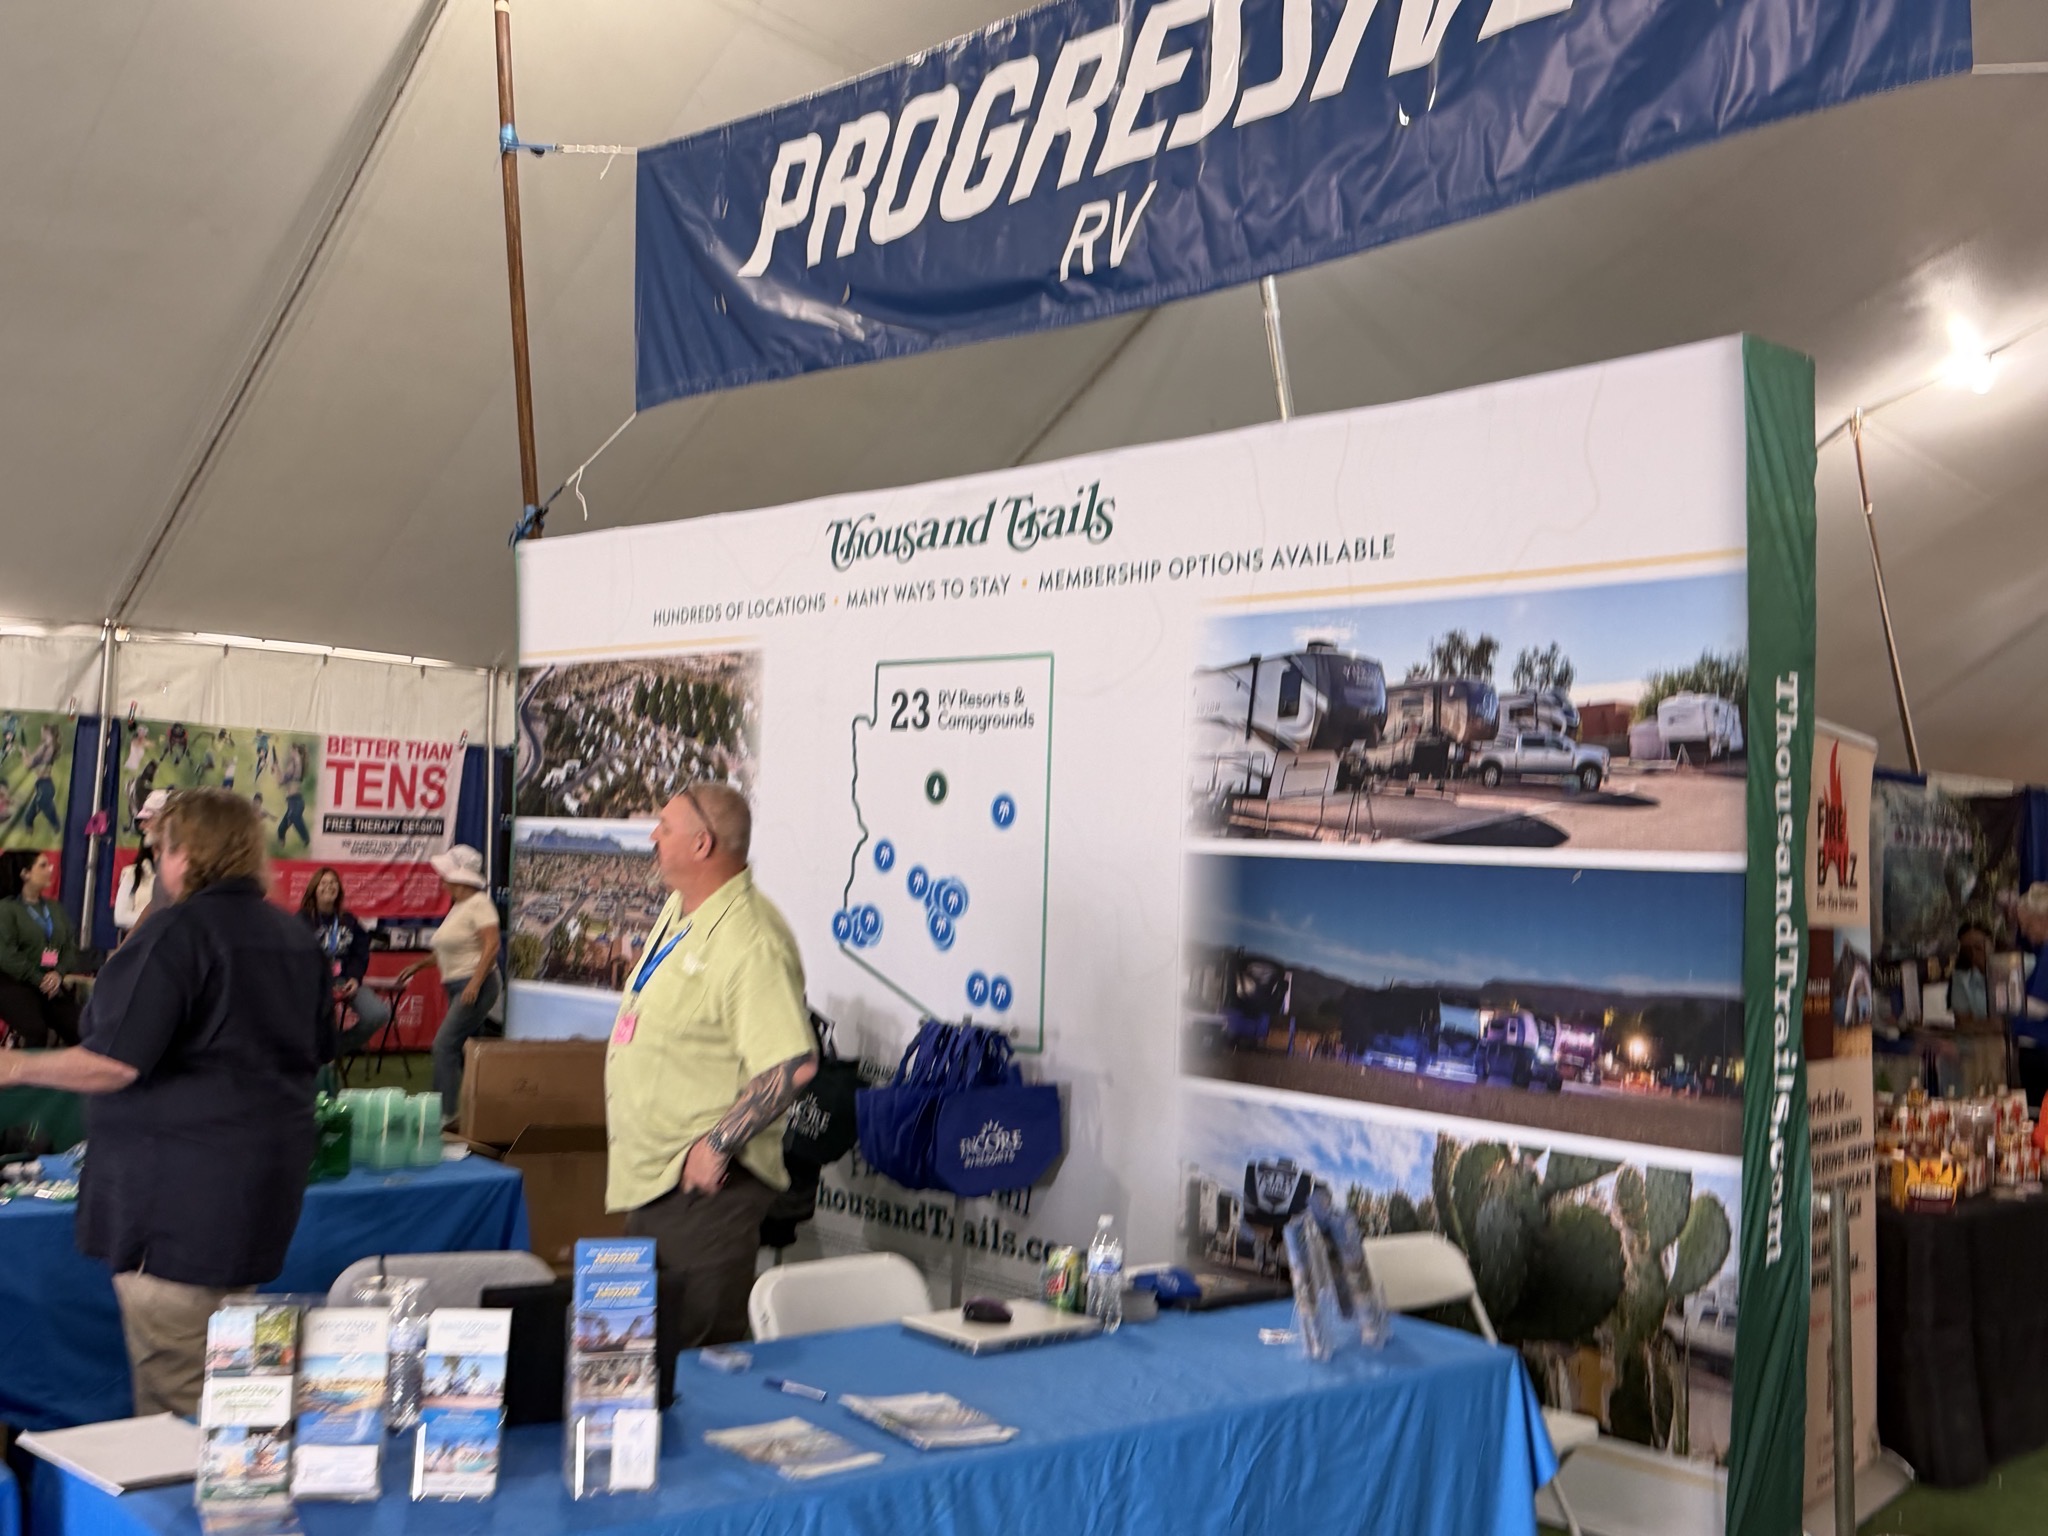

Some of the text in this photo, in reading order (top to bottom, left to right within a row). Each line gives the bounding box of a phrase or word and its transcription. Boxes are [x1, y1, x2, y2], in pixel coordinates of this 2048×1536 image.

[1059, 180, 1157, 282] RV
[826, 478, 1116, 572] Thousand Trails
[652, 534, 1396, 628] HUNDREDS OF LOCATIONS MANY WAYS TO STAY MEMBERSHIP OPTIONS AVAILABLE
[890, 687, 931, 732] 23
[937, 707, 1035, 735] Campgrounds
[938, 688, 958, 710] RV
[958, 687, 1011, 709] Resorts
[327, 735, 453, 761] BETTER THAN
[326, 758, 448, 812] TENS
[325, 817, 443, 835] FREE THERAPY SESSION
[1765, 670, 1799, 1270] ThousandTrails.com
